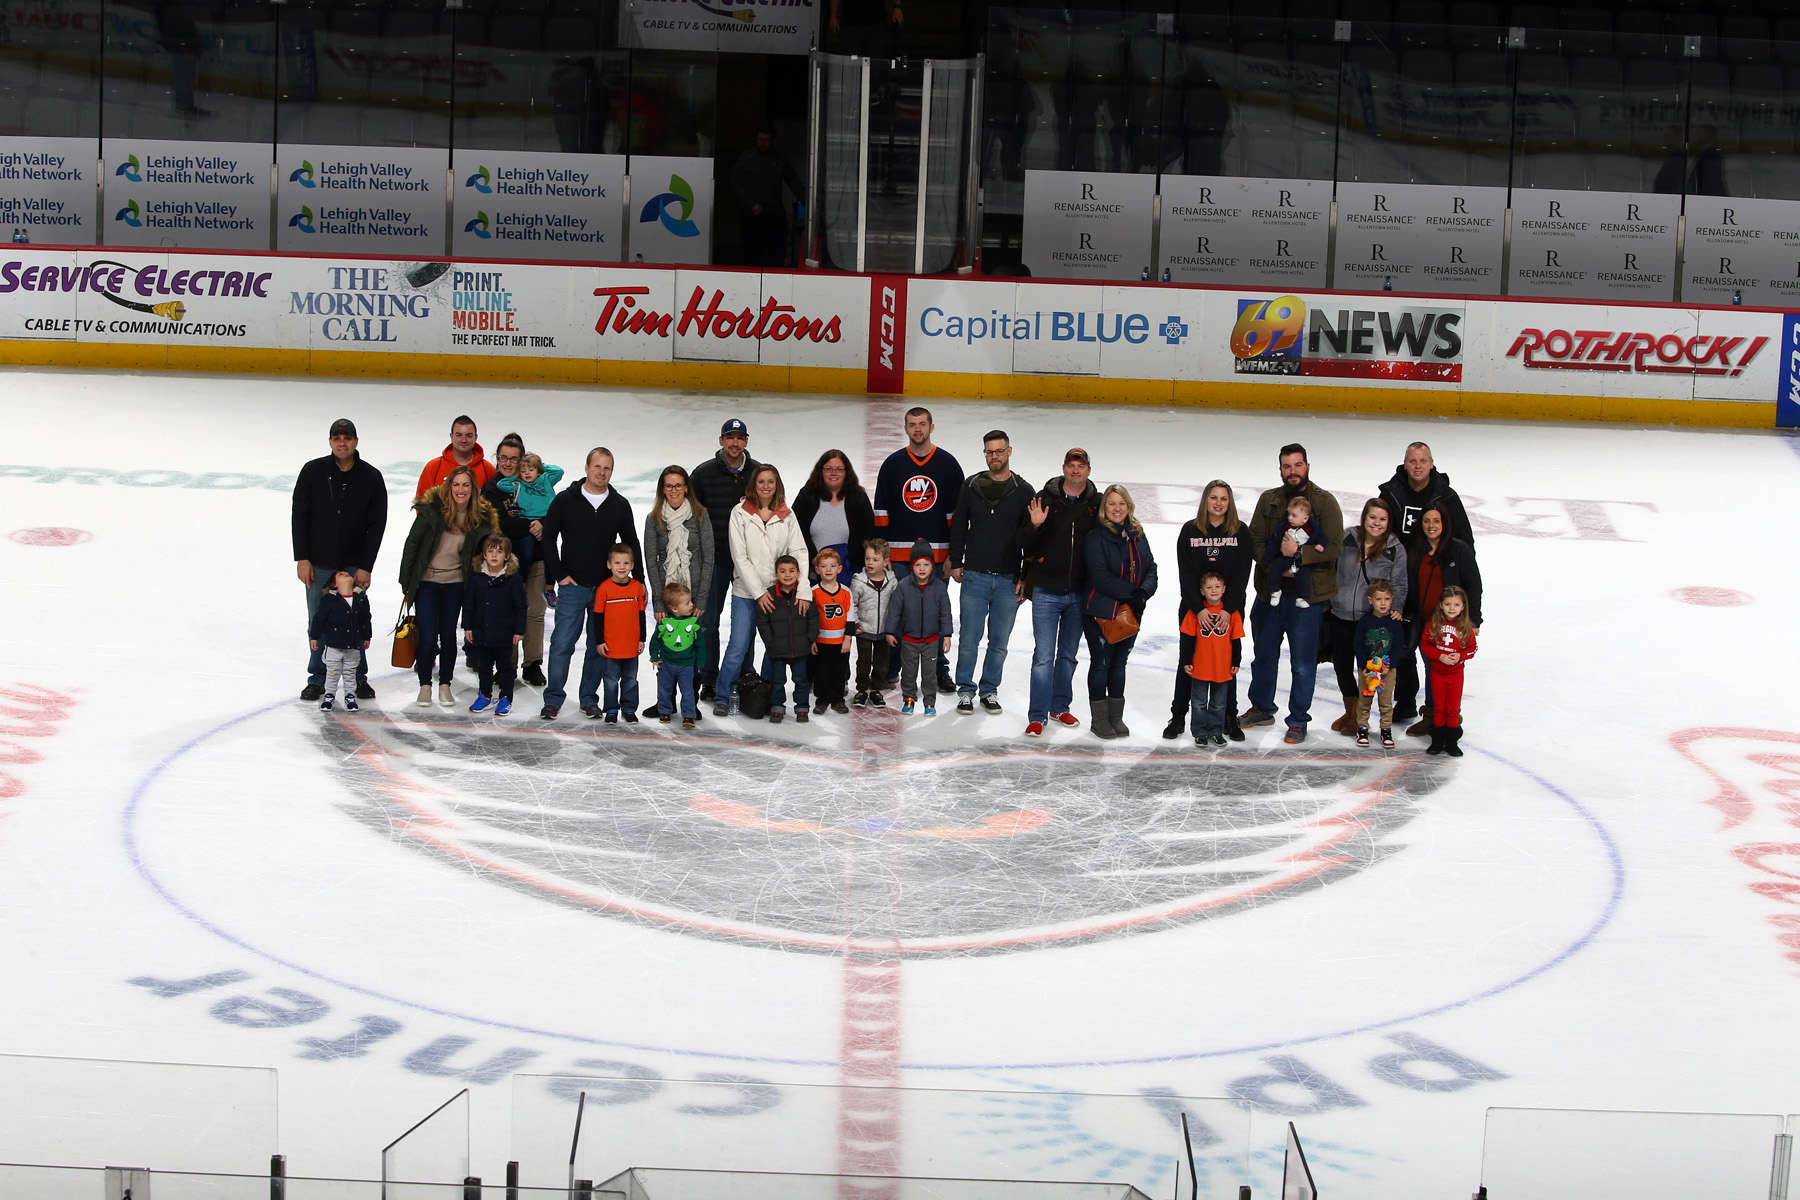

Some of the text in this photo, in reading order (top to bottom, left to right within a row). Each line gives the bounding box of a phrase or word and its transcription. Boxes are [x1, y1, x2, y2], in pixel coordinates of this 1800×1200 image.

[644, 20, 798, 34] CABLE TV & COMMUNICATIONS
[23, 153, 65, 169] Valley
[147, 156, 238, 173] Lehigh Valley
[23, 168, 82, 180] Network
[146, 170, 254, 185] Health Network
[321, 162, 412, 179] Lehigh Valley
[497, 168, 588, 185] Lehigh Valley
[320, 176, 429, 191] Health Network
[496, 182, 606, 197] Health Network
[1081, 183, 1098, 200] R
[1200, 187, 1216, 204] R
[1278, 190, 1296, 208] R
[1374, 194, 1390, 212] R
[23, 198, 65, 214] Valley
[147, 201, 238, 218] Lehigh Valley
[1453, 197, 1470, 214] R
[1548, 200, 1565, 218] R
[1626, 204, 1642, 221] R
[23, 212, 82, 226] Network
[146, 216, 254, 230] Health Network
[320, 207, 412, 224] Lehigh Valley
[496, 213, 588, 230] Lehigh Valley
[1722, 208, 1738, 226] R
[320, 222, 428, 236] Health Network
[496, 228, 604, 242] Health Network
[1079, 232, 1096, 250] R
[1196, 236, 1214, 254] R
[1276, 240, 1293, 257] R
[1371, 244, 1388, 262] R
[1451, 247, 1468, 264] R
[1545, 250, 1562, 268] R
[1624, 253, 1640, 271] R
[1719, 258, 1735, 274] R
[0, 261, 272, 298] SERVICE ELECTRIC
[328, 267, 388, 292] THE
[453, 272, 506, 292] PRINT.
[289, 292, 430, 318] MORNING
[452, 291, 517, 312] ONLINE.
[452, 311, 520, 332] MOBILE.
[593, 285, 842, 344] Tim Hortons
[25, 318, 246, 336] CABLE TV & COMMUNICATIONS
[322, 318, 398, 342] CALL
[880, 285, 896, 371] CCM
[920, 307, 1040, 345] Capital
[1230, 295, 1462, 359] 69 NEWS
[452, 334, 556, 348] THE PERFECT HAT TRICK.
[1506, 328, 1771, 378] ROTHROCK!
[1236, 359, 1300, 374] WFMZ-TV
